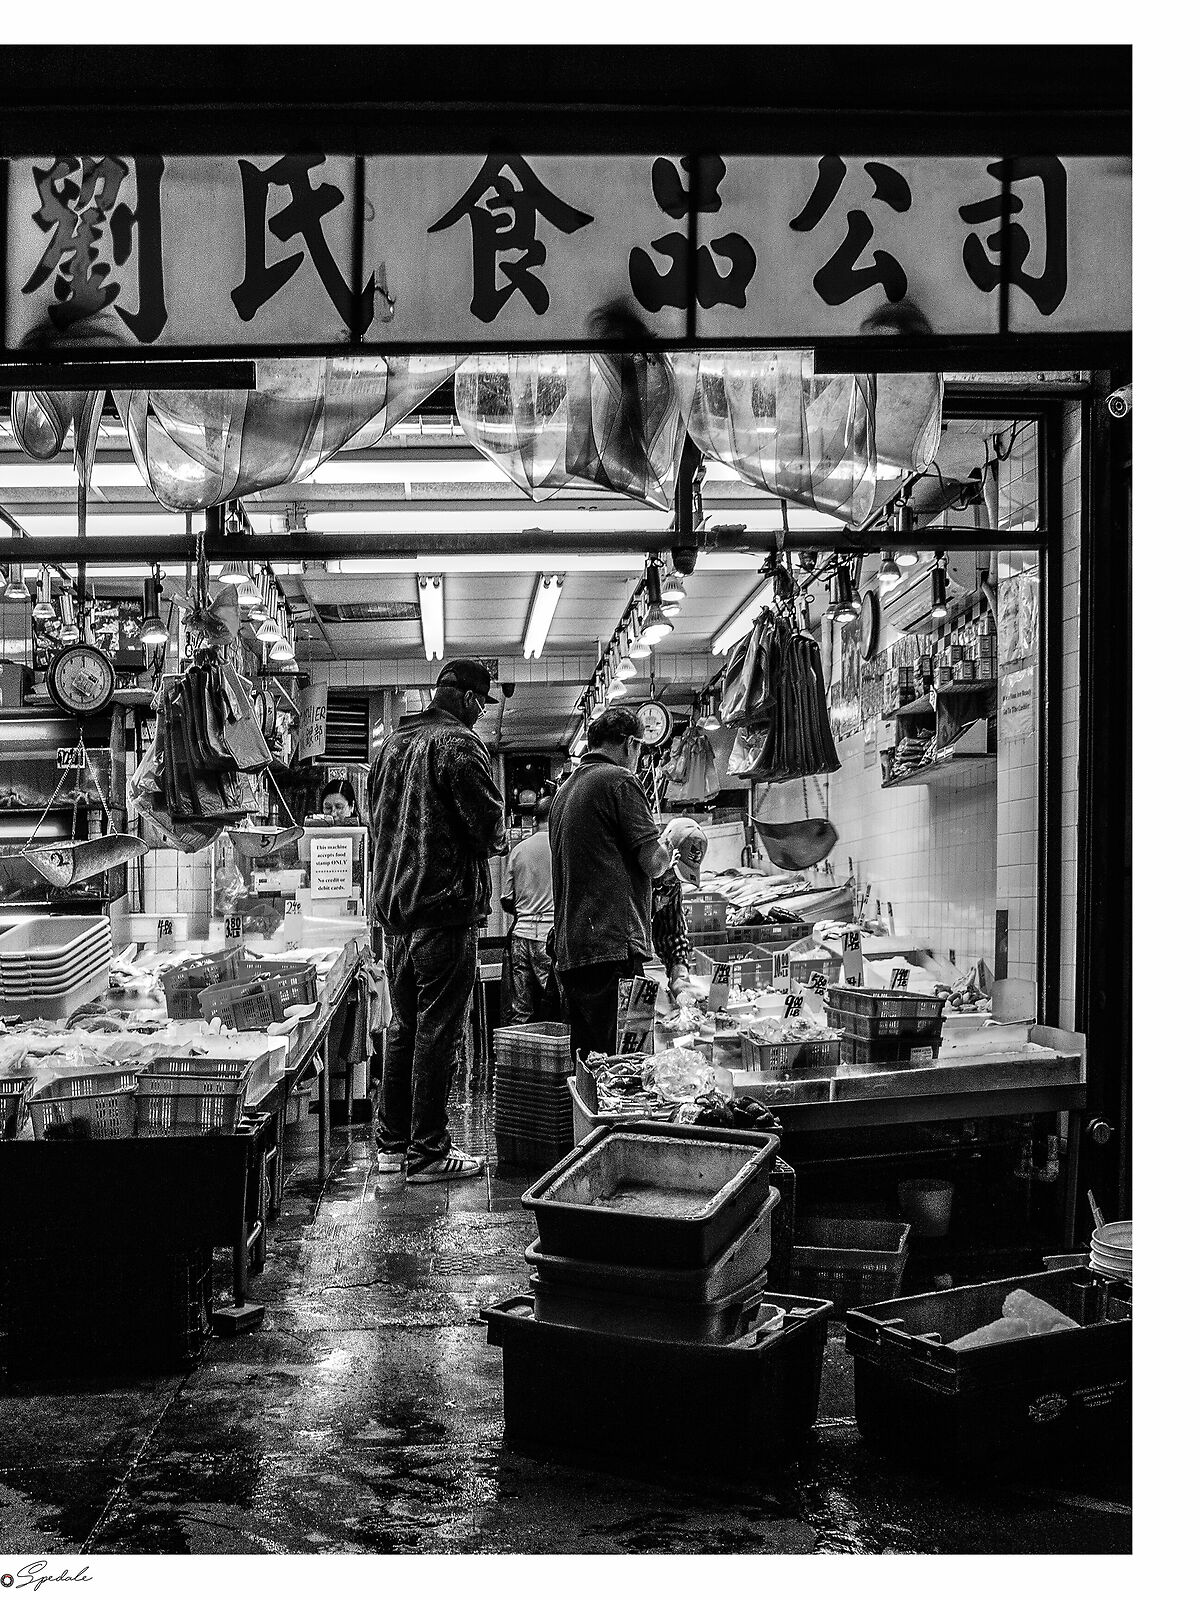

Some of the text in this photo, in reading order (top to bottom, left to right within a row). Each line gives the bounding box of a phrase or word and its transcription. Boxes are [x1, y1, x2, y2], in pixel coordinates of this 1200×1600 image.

[21, 153, 1067, 344] 劉氏食品公司
[260, 834, 271, 848] 5
